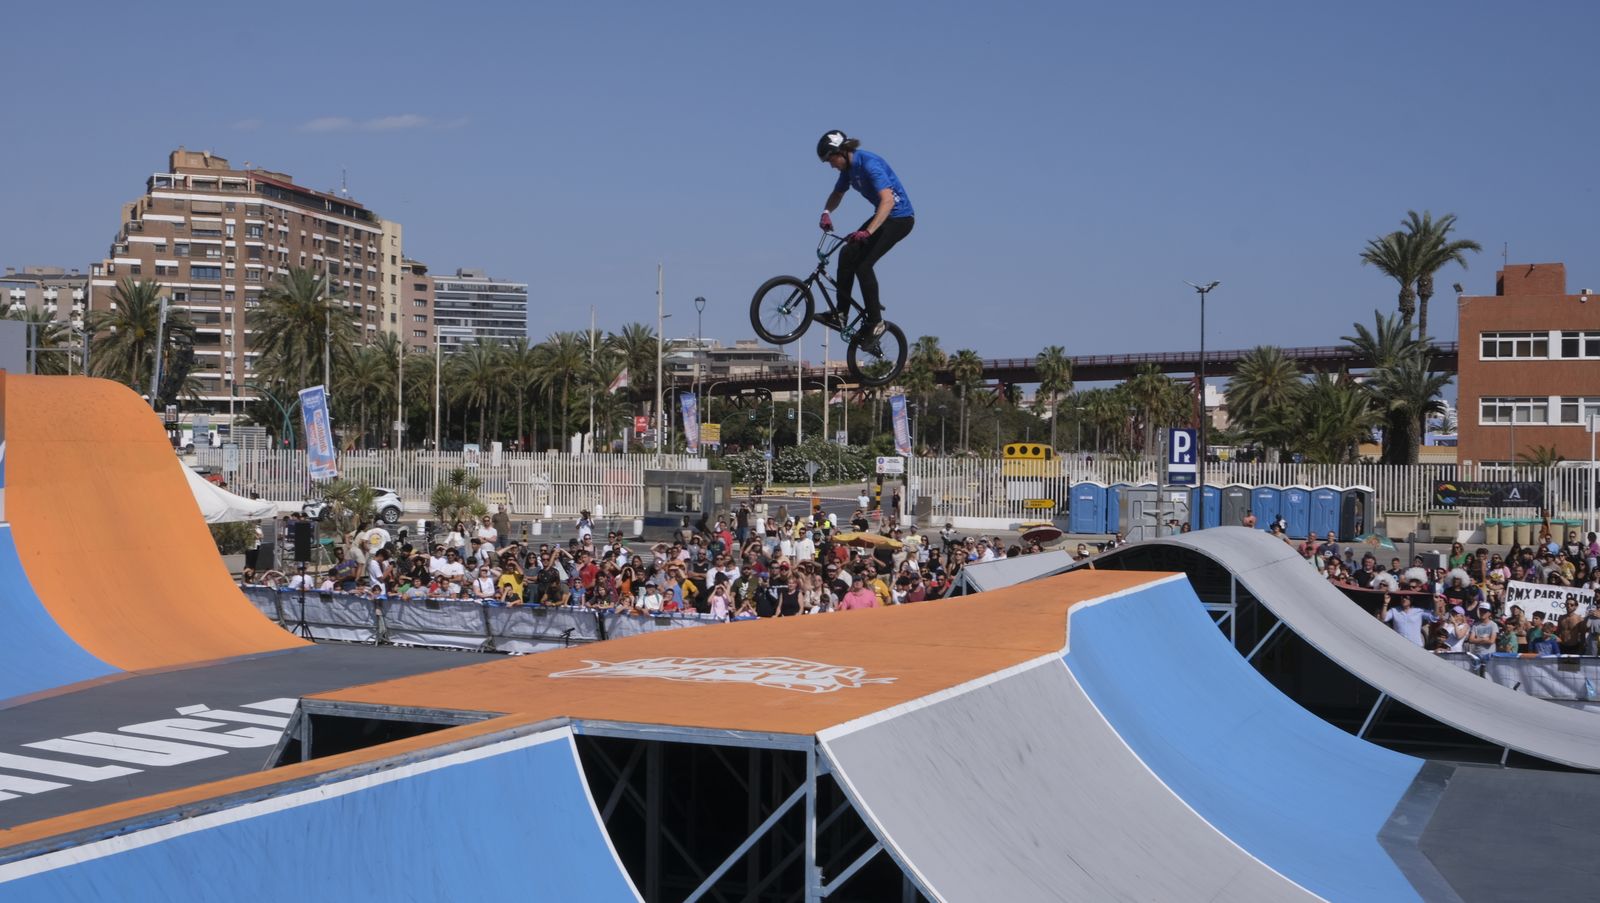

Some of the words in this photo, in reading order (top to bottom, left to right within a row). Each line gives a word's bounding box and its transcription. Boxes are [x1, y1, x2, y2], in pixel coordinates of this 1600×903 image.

[1174, 431, 1191, 462] P
[1507, 587, 1532, 602] BMX
[1534, 589, 1563, 600] PARK
[1548, 612, 1559, 621] AL
